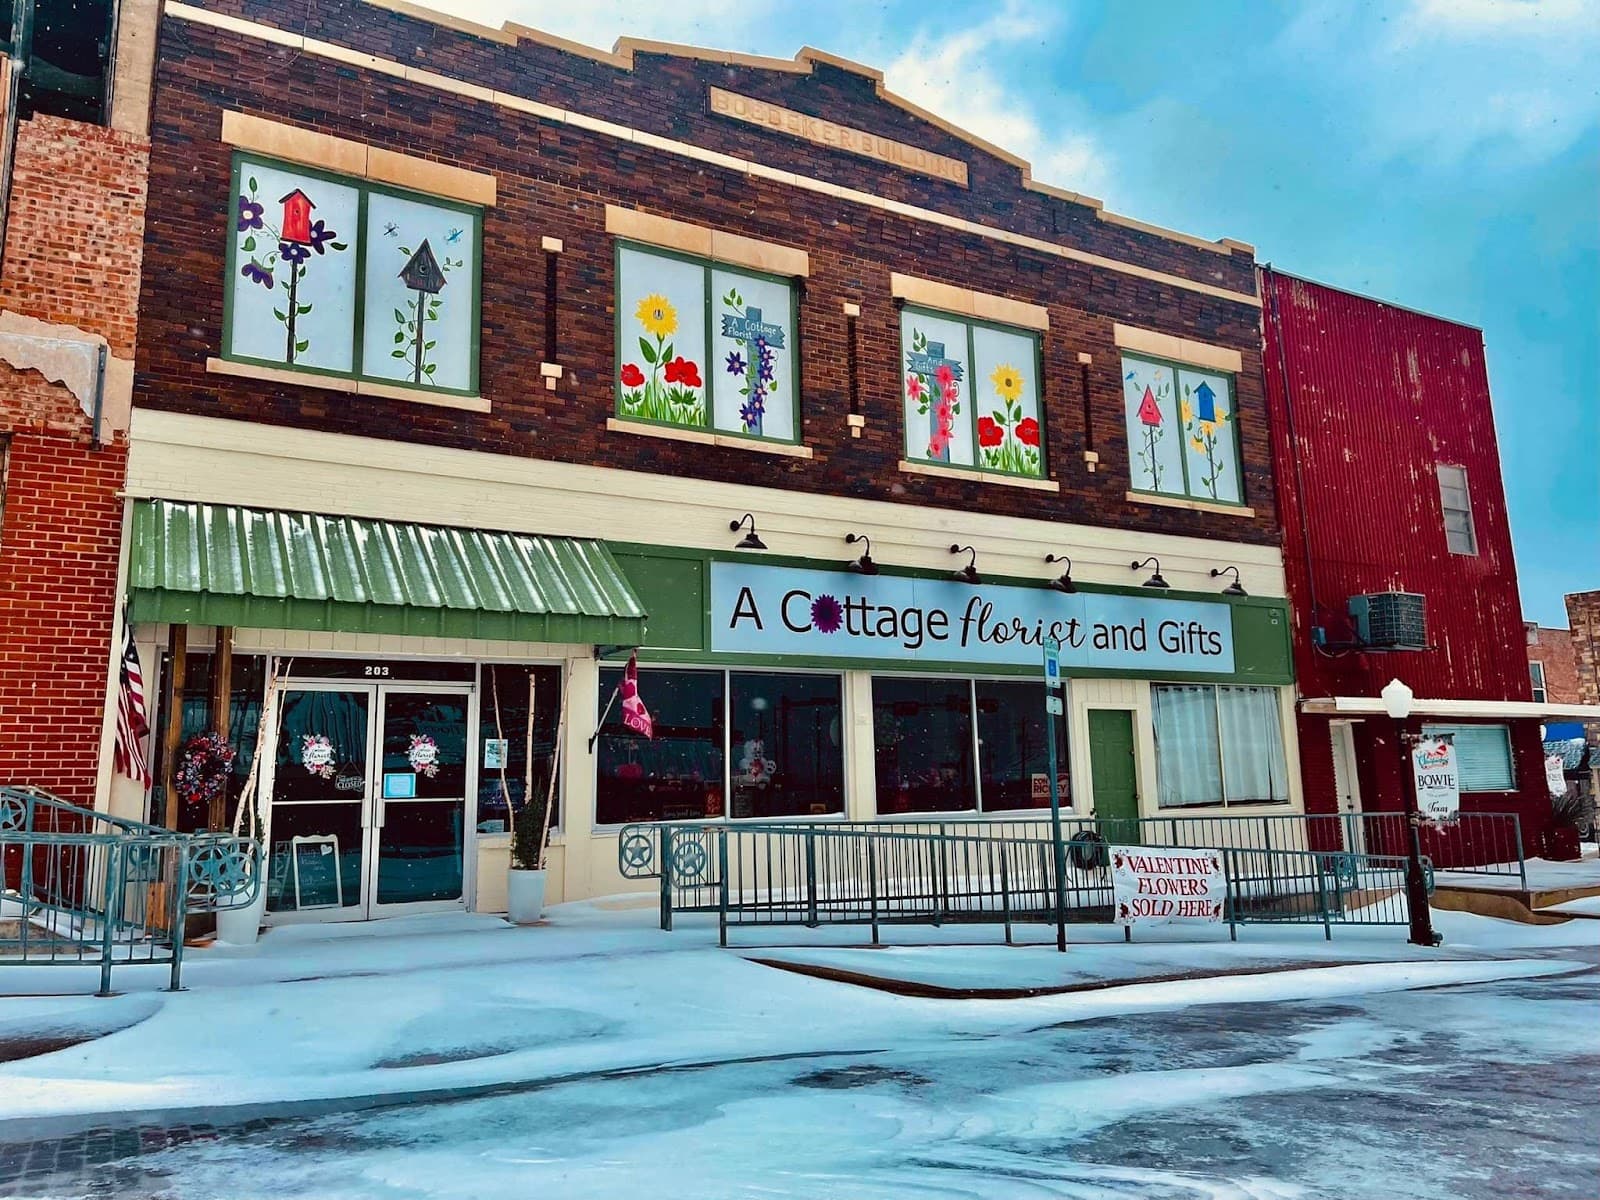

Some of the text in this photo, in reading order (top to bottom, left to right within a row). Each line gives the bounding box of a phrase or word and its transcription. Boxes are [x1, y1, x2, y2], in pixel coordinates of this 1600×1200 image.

[714, 92, 966, 180] BOEDEKER BUILDING
[728, 327, 753, 340] Florist
[731, 317, 777, 338] A Cottage
[729, 587, 763, 630] A
[959, 596, 1086, 650] florist
[1093, 618, 1146, 651] and
[1158, 620, 1222, 656] Gifts
[365, 666, 389, 676] 203
[624, 713, 651, 738] LOVE
[1033, 784, 1066, 793] RICEY
[1418, 774, 1455, 787] BOWIE
[1428, 801, 1448, 812] Texas
[1127, 856, 1211, 874] VALENTINE
[1137, 877, 1208, 895] FLOWERS
[1132, 899, 1212, 917] SOLD HERE
